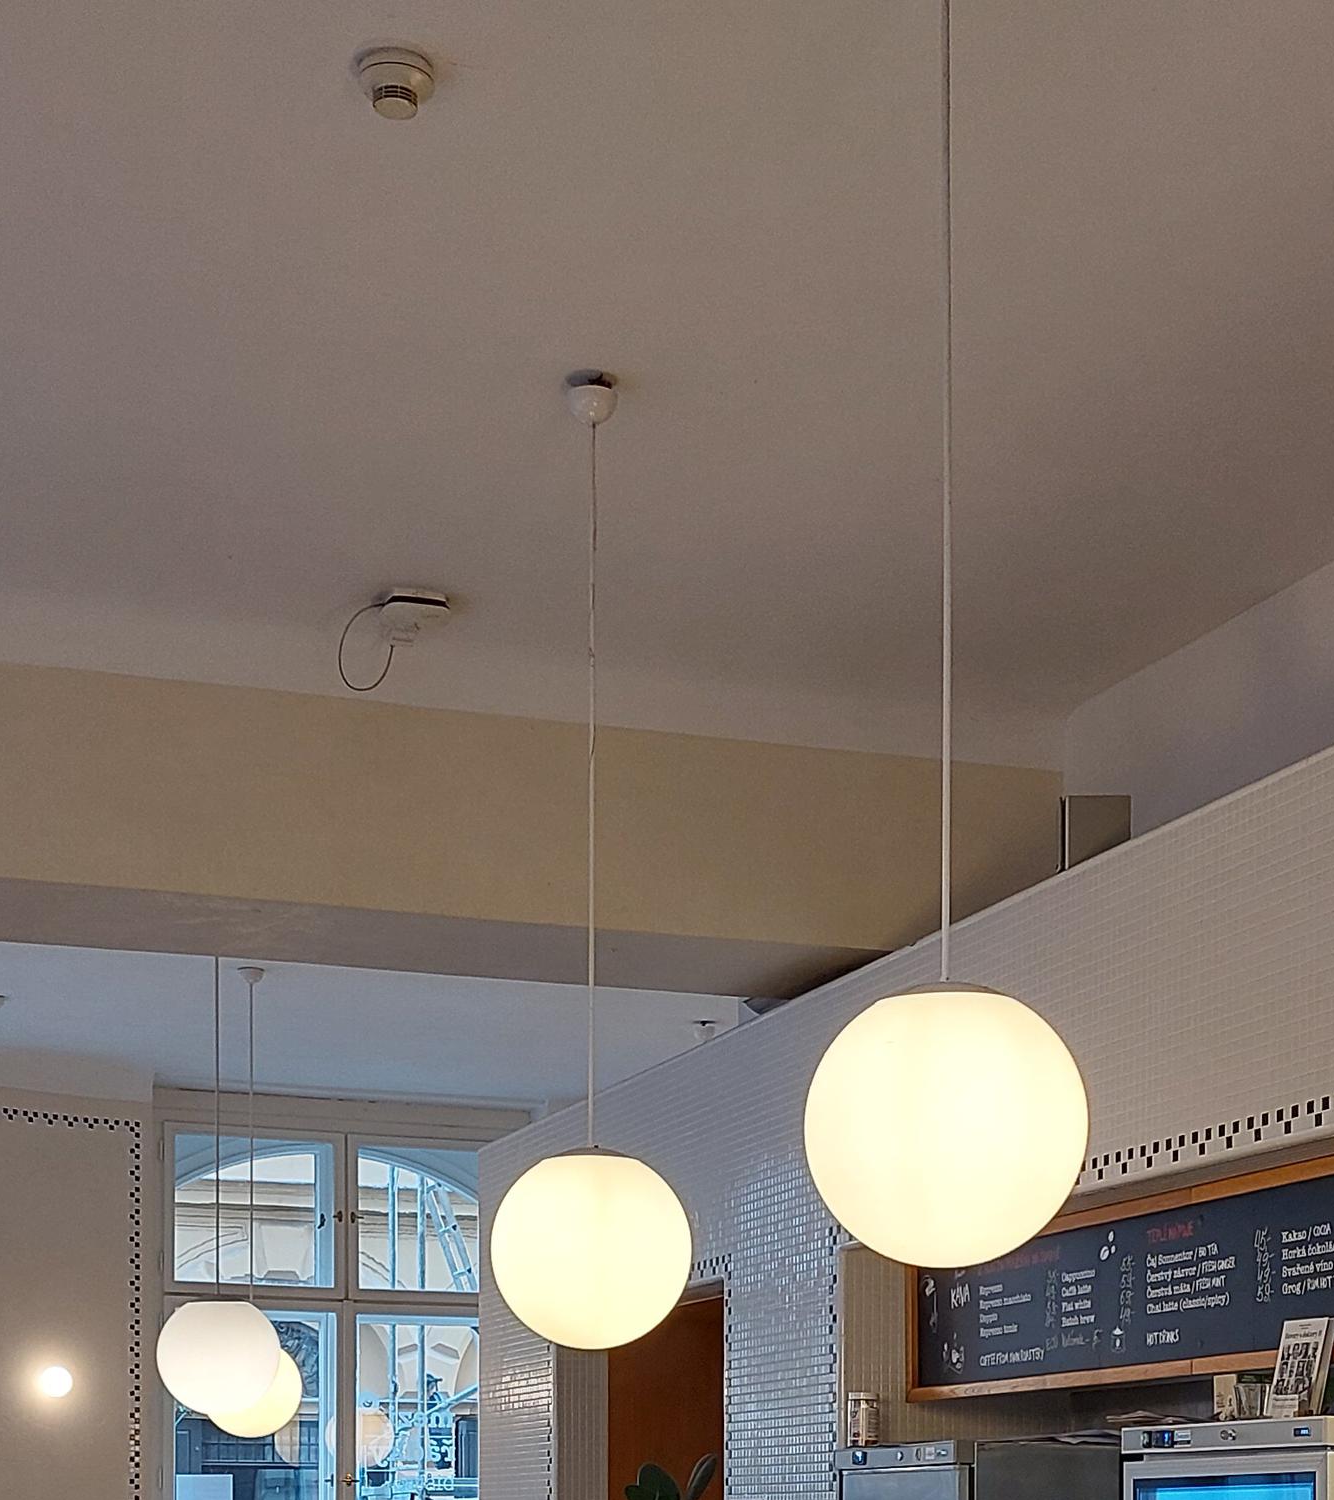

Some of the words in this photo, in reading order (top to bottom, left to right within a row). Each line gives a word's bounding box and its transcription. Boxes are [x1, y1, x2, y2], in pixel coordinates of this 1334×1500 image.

[1281, 1232, 1306, 1243] Kakao
[1281, 1249, 1306, 1260] Horká
[1282, 1265, 1314, 1278] Svařené
[1316, 1261, 1333, 1271] víno
[1282, 1282, 1301, 1295] Grog
